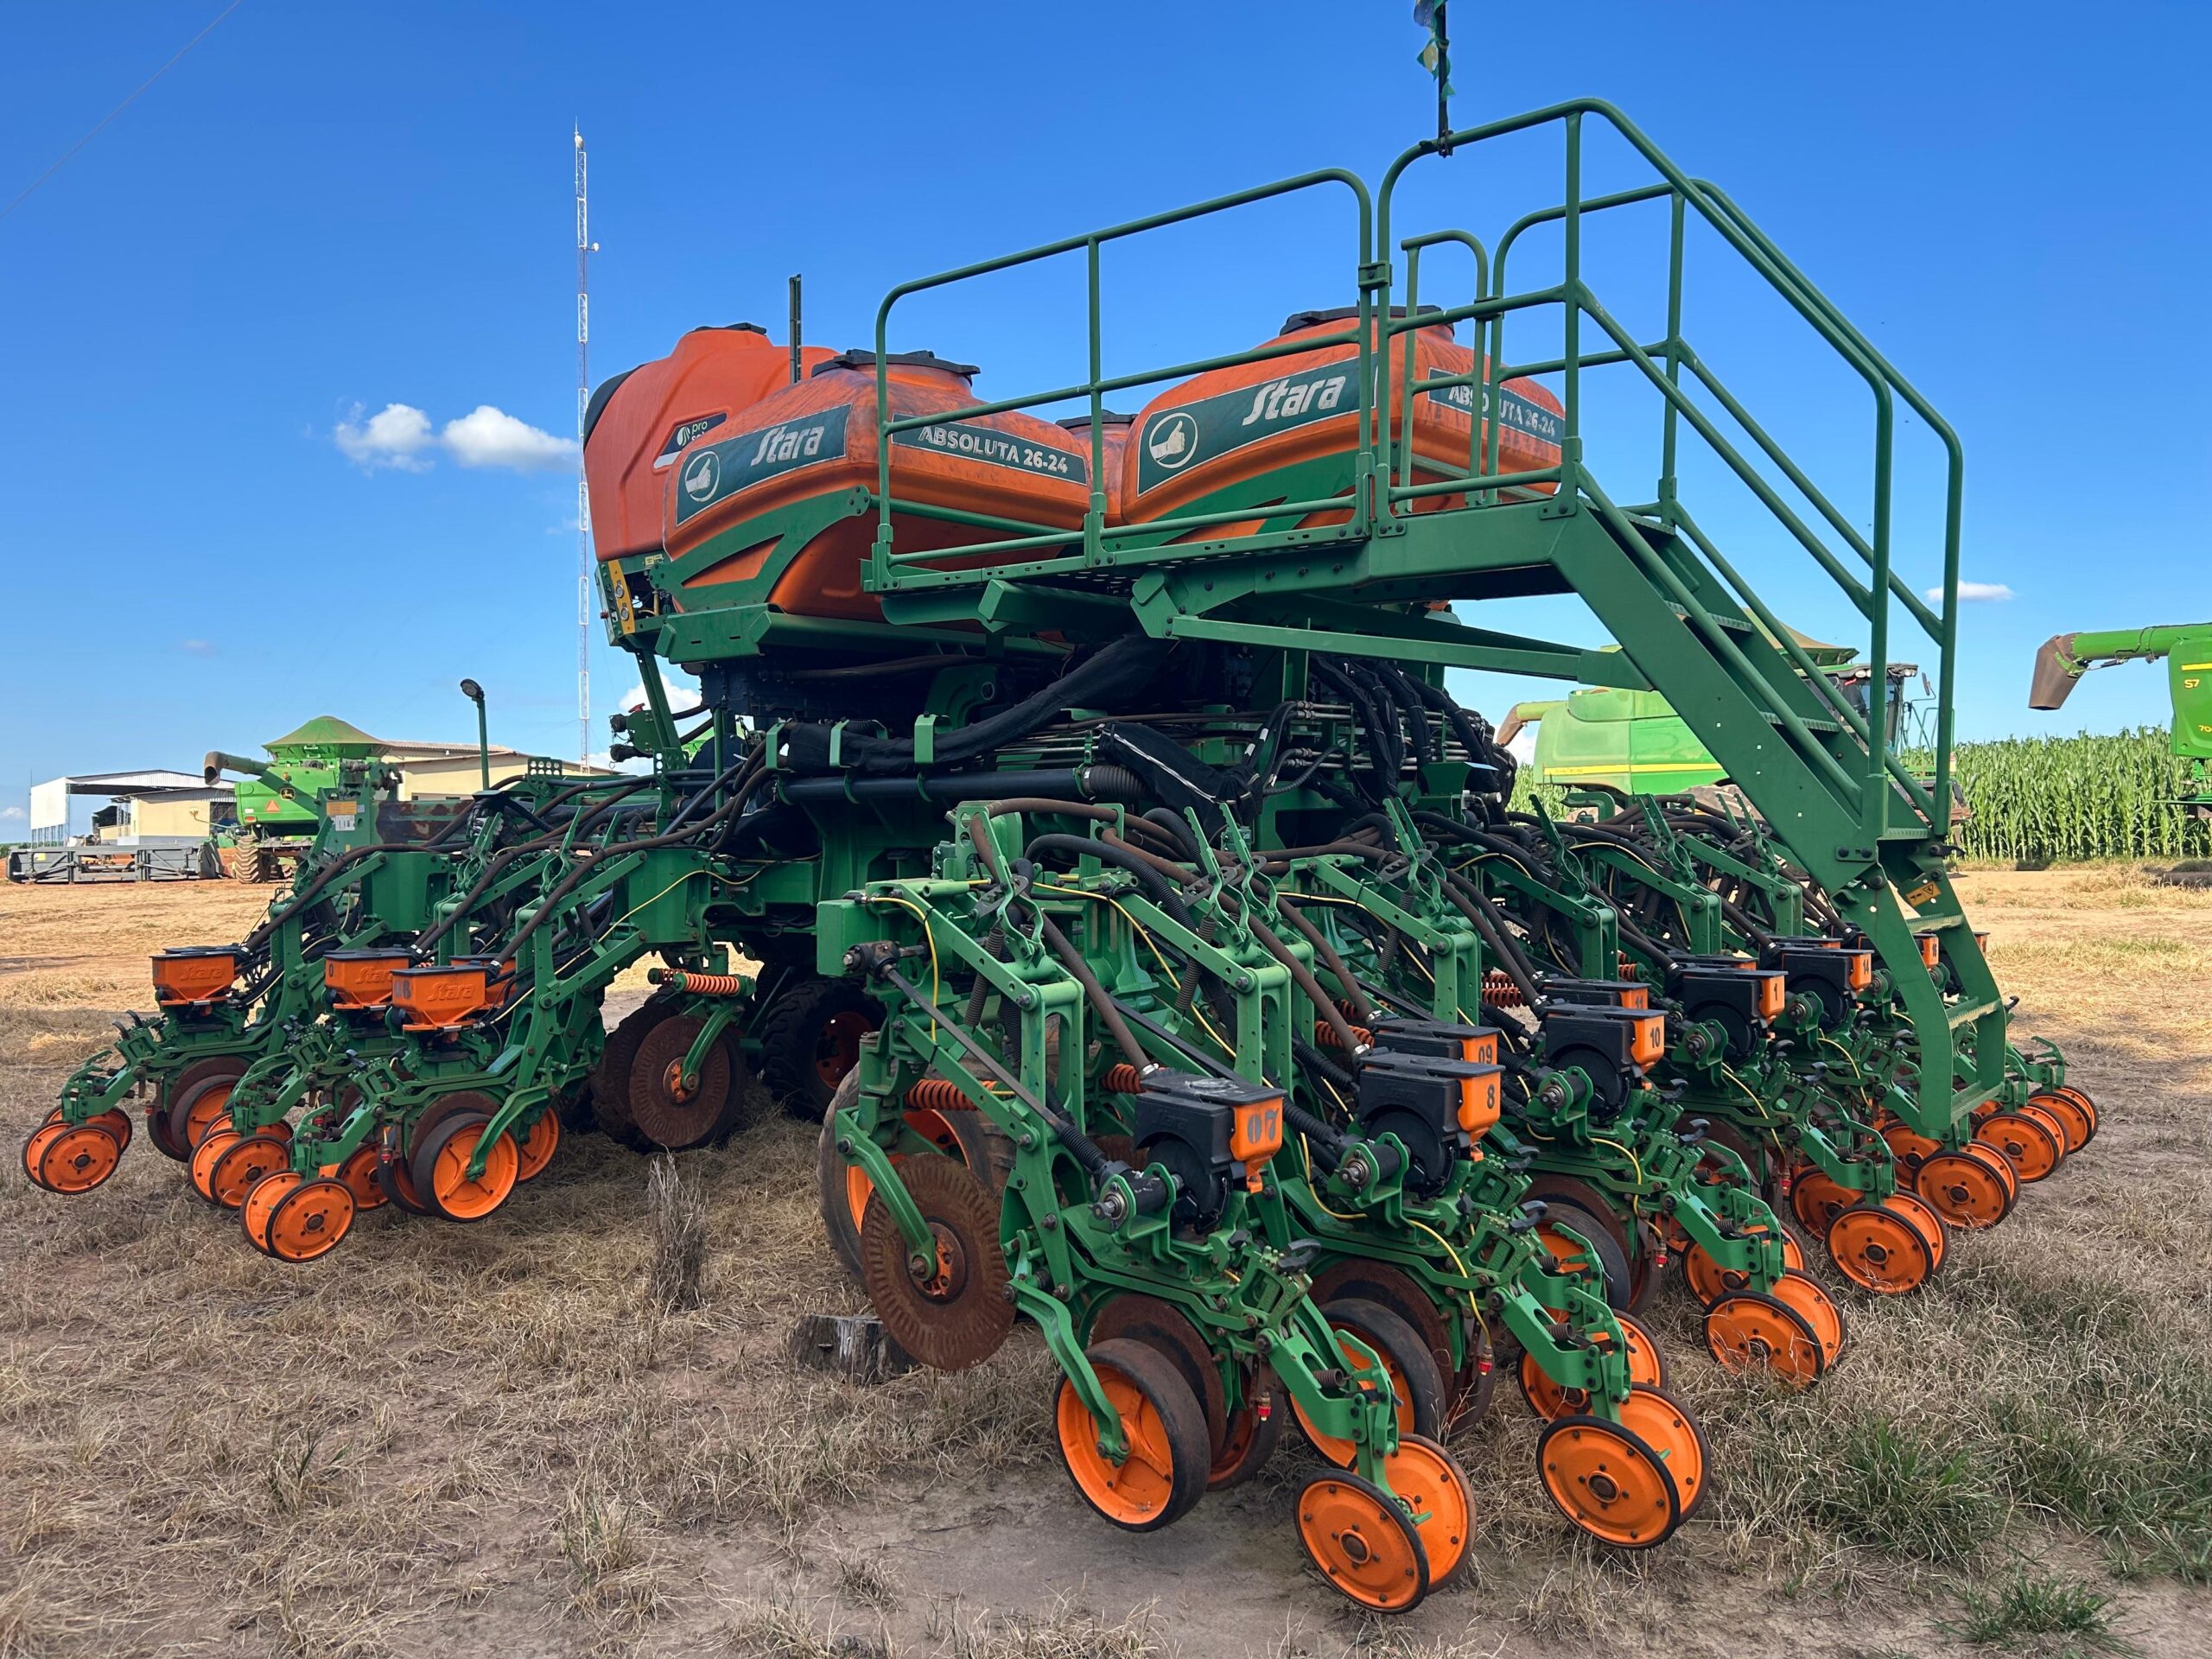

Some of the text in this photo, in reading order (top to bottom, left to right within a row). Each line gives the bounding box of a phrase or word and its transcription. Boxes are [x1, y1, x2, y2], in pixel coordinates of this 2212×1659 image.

[1243, 376, 1346, 426] Stara
[1448, 385, 1523, 425] ABOUTA
[692, 421, 708, 435] pro
[751, 426, 824, 467] Stara
[918, 425, 1068, 474] ABSOLUTA 26-24
[2183, 678, 2200, 689] S7
[429, 982, 474, 1001] Stara
[1649, 1026, 1661, 1048] 10
[1478, 1043, 1493, 1064] 09
[1486, 1084, 1495, 1109] 8
[1247, 1109, 1279, 1145] 07
